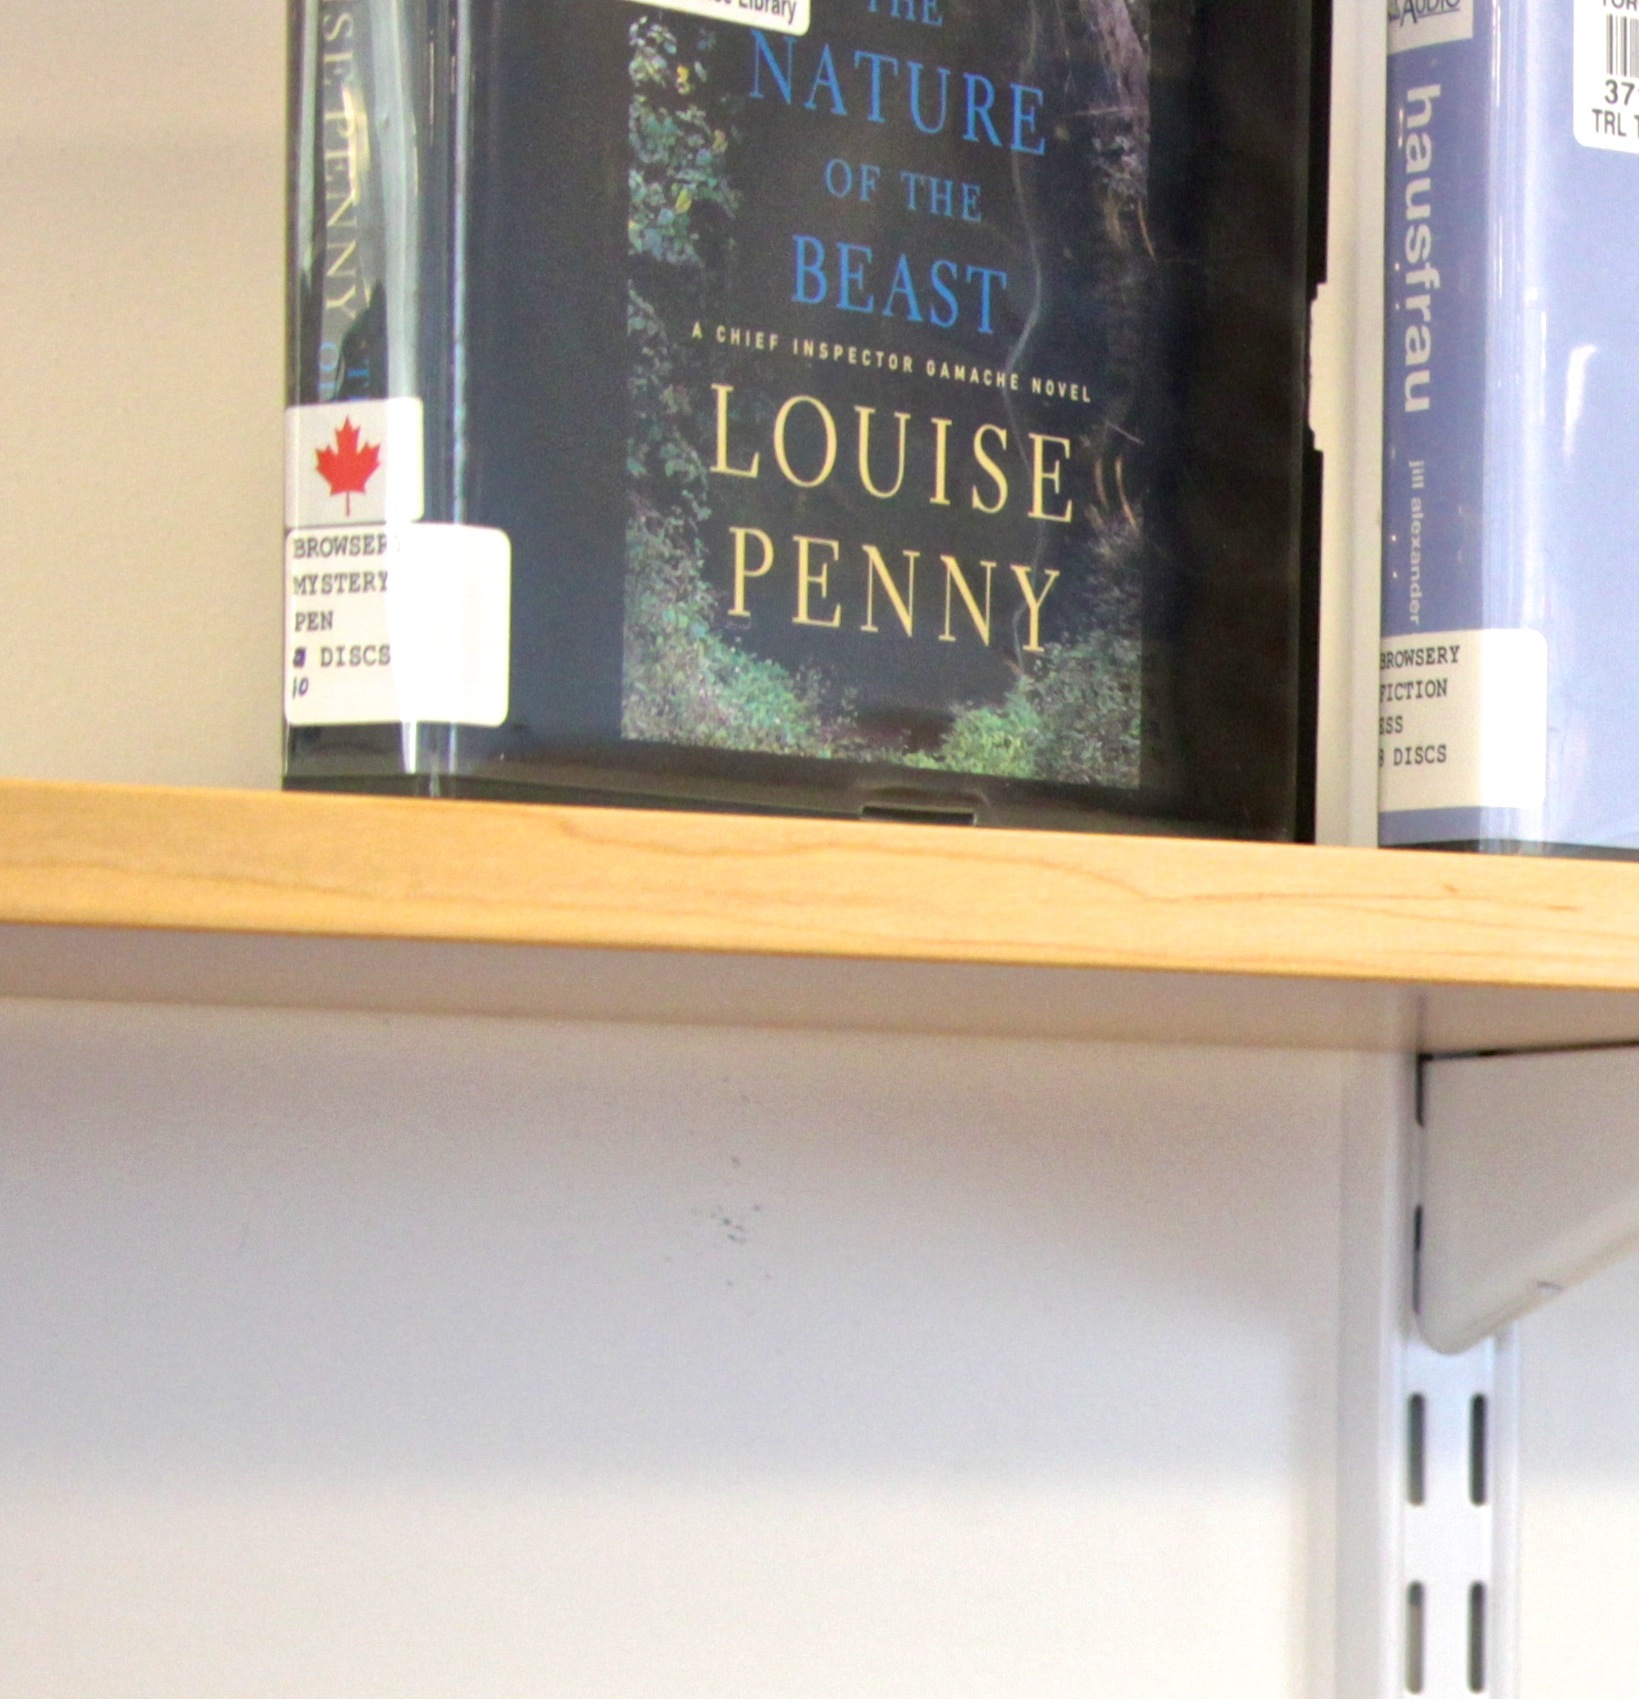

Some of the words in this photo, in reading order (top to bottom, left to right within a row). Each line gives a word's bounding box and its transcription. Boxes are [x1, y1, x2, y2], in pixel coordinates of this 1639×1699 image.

[749, 28, 1047, 155] NATURE
[1592, 109, 1627, 137] TRL
[824, 157, 881, 201] OF
[901, 169, 983, 223] THE
[1404, 84, 1441, 413] hausfrau
[791, 233, 1008, 335] BEAST
[690, 321, 704, 340] A
[715, 325, 779, 352] CHIEF
[792, 332, 914, 375] INSPECTOR
[926, 359, 1020, 391] GAMACHE
[1032, 377, 1092, 404] NOVEL
[709, 383, 1073, 524] LOUISE
[293, 570, 389, 596] MYSTERY
[726, 525, 1061, 654] PENNY
[294, 611, 334, 633] PEN
[319, 644, 391, 668] DISCS
[1380, 644, 1461, 670] BROWSERY
[1380, 678, 1448, 703] FICTION
[1393, 744, 1447, 766] DISCS
